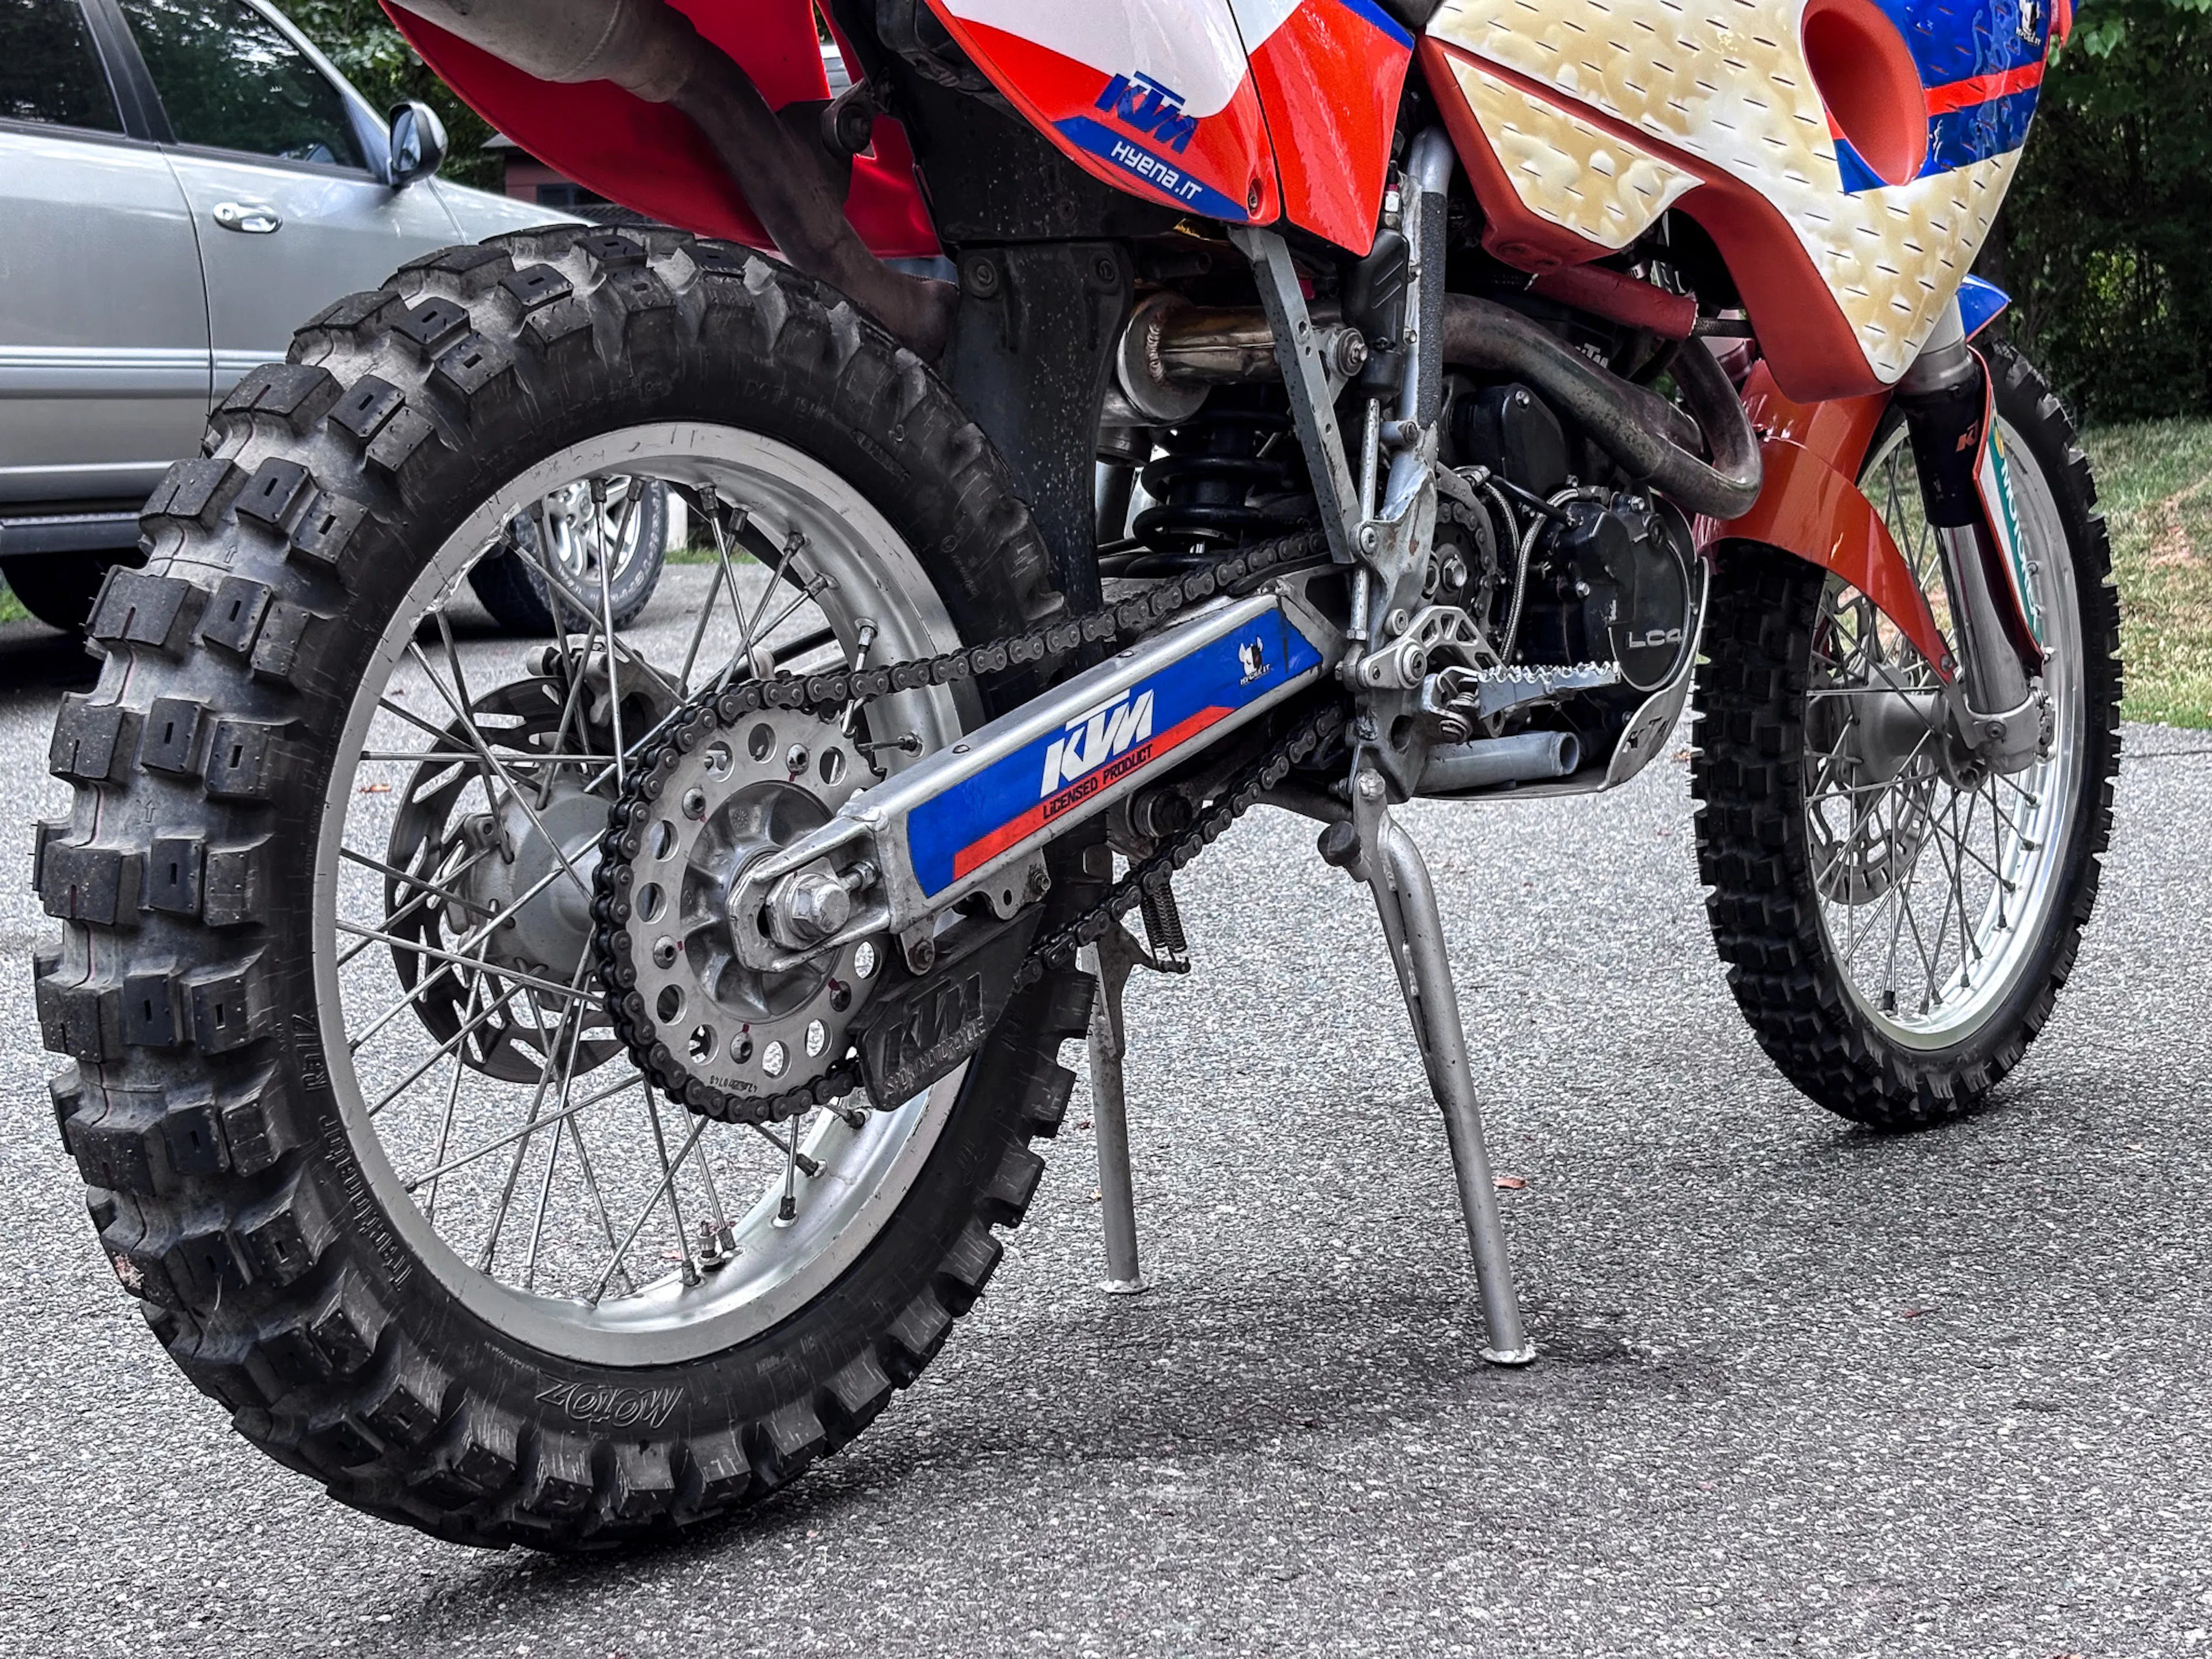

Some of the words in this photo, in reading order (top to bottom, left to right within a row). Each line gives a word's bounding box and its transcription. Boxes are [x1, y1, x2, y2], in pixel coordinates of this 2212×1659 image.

[1094, 70, 1200, 154] KTM
[1626, 628, 1684, 649] LC4
[1040, 688, 1154, 798] KTM
[1103, 744, 1153, 785] PRODUCT
